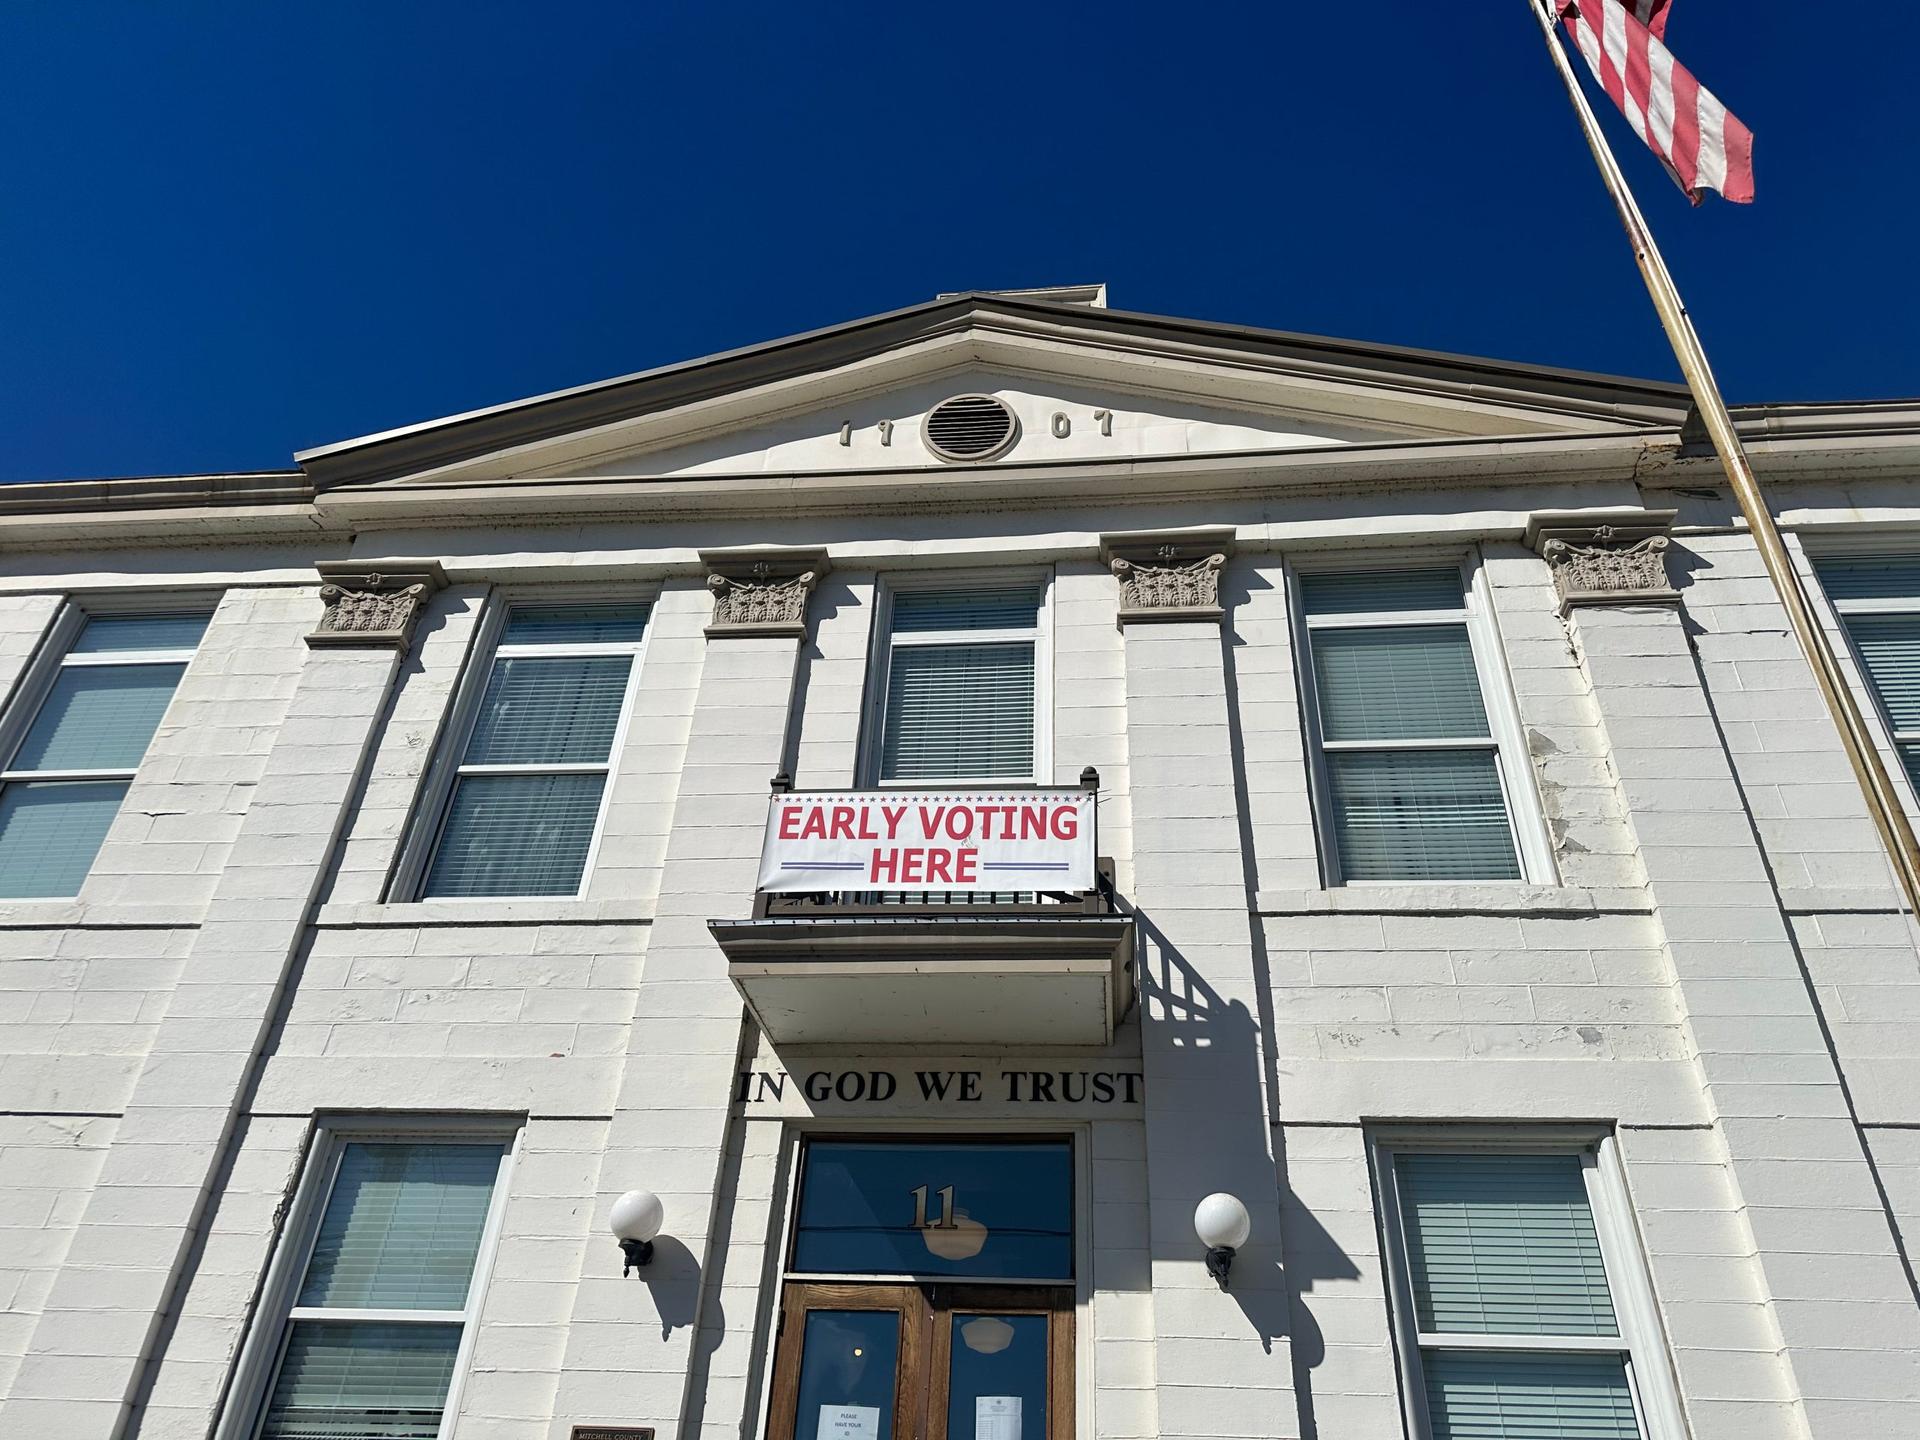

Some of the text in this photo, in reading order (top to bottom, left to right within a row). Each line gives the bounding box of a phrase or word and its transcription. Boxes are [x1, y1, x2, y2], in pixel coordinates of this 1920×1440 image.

[778, 805, 1079, 841] EARLY VOTING
[870, 848, 978, 883] HERE
[738, 1071, 1144, 1104] IN GOD WE TRUST
[909, 1184, 958, 1230] 11
